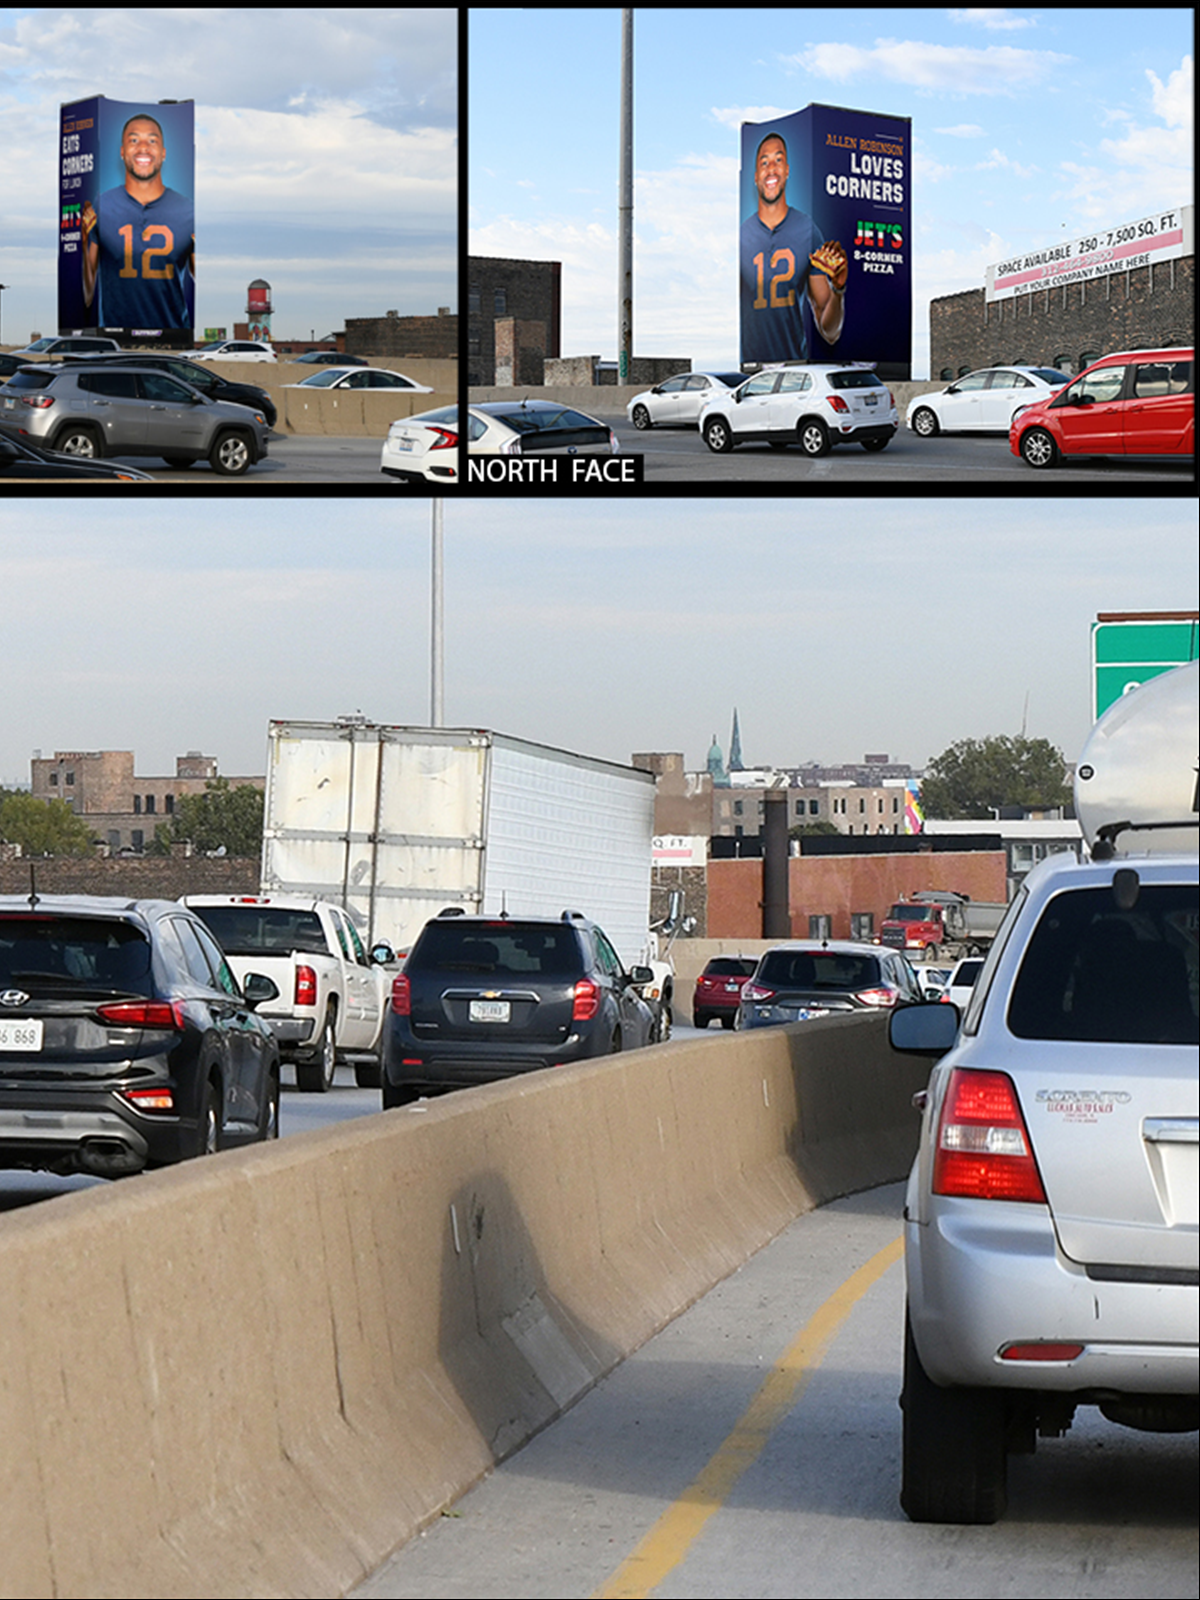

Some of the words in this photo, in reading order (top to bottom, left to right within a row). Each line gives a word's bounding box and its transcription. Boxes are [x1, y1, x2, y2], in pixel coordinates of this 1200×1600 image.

[826, 134, 857, 149] ALLEN
[860, 138, 903, 156] ROBINSON
[851, 153, 903, 179] LOVES
[826, 174, 903, 204] CORNERS
[854, 220, 903, 249] JET'S
[998, 258, 1022, 277] SPACE
[1023, 245, 1072, 270] AVAILABLE
[1078, 237, 1098, 254] 250
[1106, 226, 1136, 247] 7,500
[1137, 220, 1158, 238] SQ.
[1160, 213, 1178, 231] FT.
[118, 224, 174, 280] 12
[854, 250, 903, 264] 8-CORNER
[753, 247, 796, 310] 12
[863, 262, 894, 274] PIZZA
[1013, 282, 1029, 295] PUT
[1029, 278, 1051, 292] YOUR
[1052, 268, 1093, 286] COMPANY
[1095, 260, 1124, 275] NAME
[1126, 253, 1151, 268] HERE
[653, 838, 668, 849] Q.
